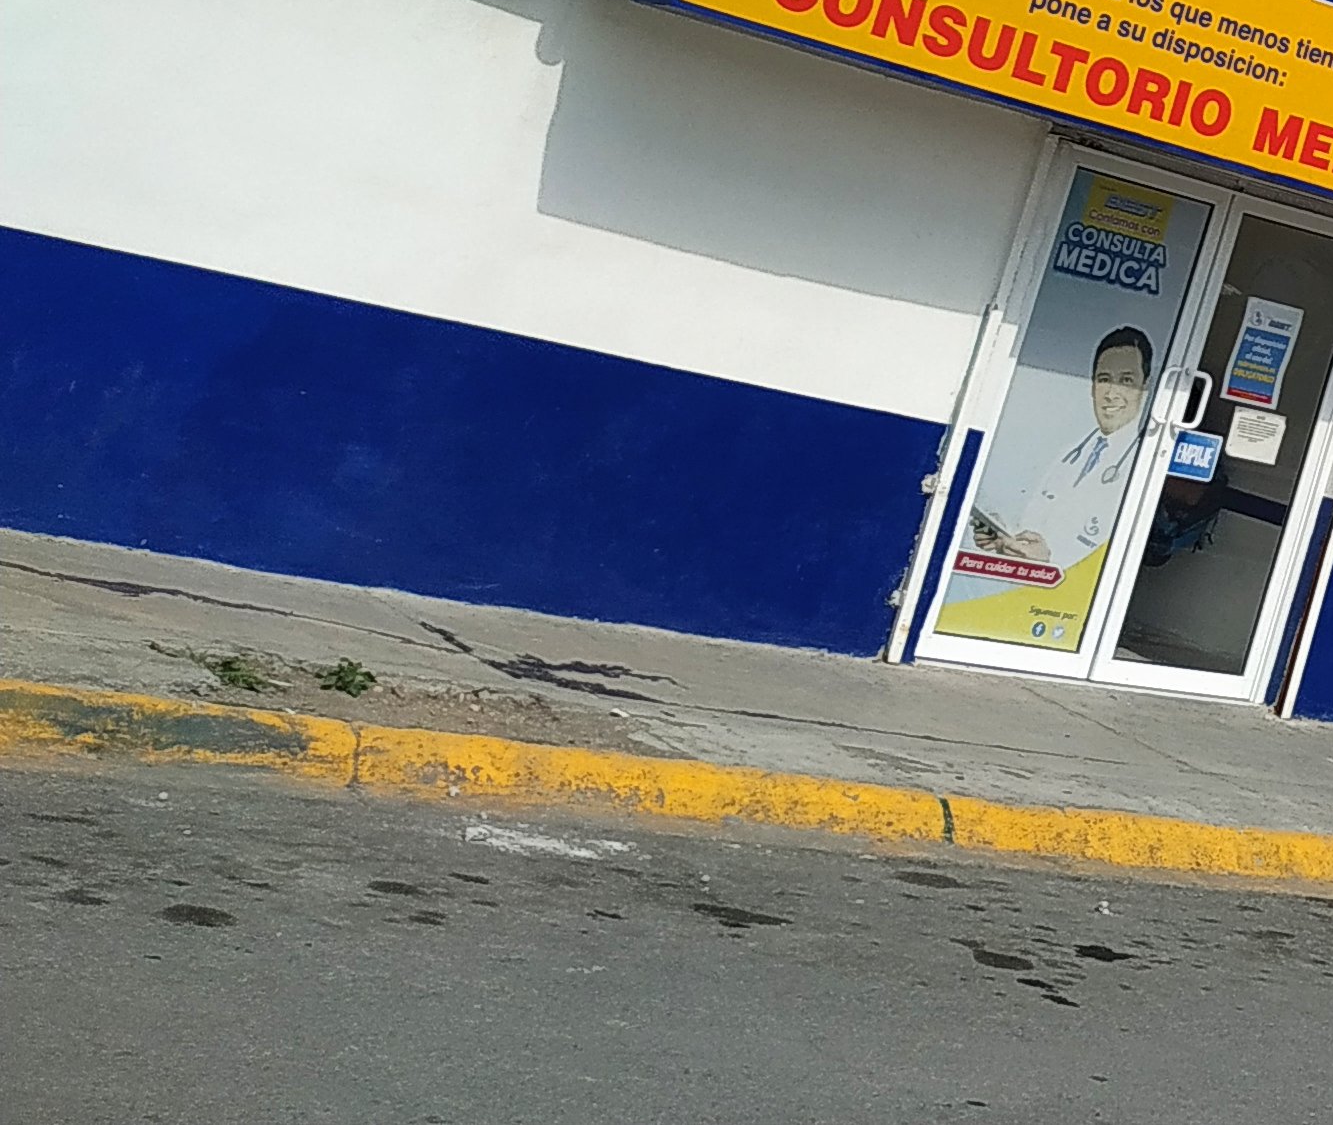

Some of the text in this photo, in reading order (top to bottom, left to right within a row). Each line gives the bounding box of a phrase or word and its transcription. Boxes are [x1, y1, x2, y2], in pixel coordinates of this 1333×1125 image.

[1096, 12, 1112, 31] a
[1116, 17, 1146, 43] su
[1152, 29, 1288, 87] disposicion:
[1169, 0, 1213, 29] que
[1217, 14, 1291, 54] menos
[1055, 243, 1159, 292] MÉDICA
[1066, 222, 1167, 266] CONSULTA
[959, 556, 1056, 581] Para cuidar tu salud
